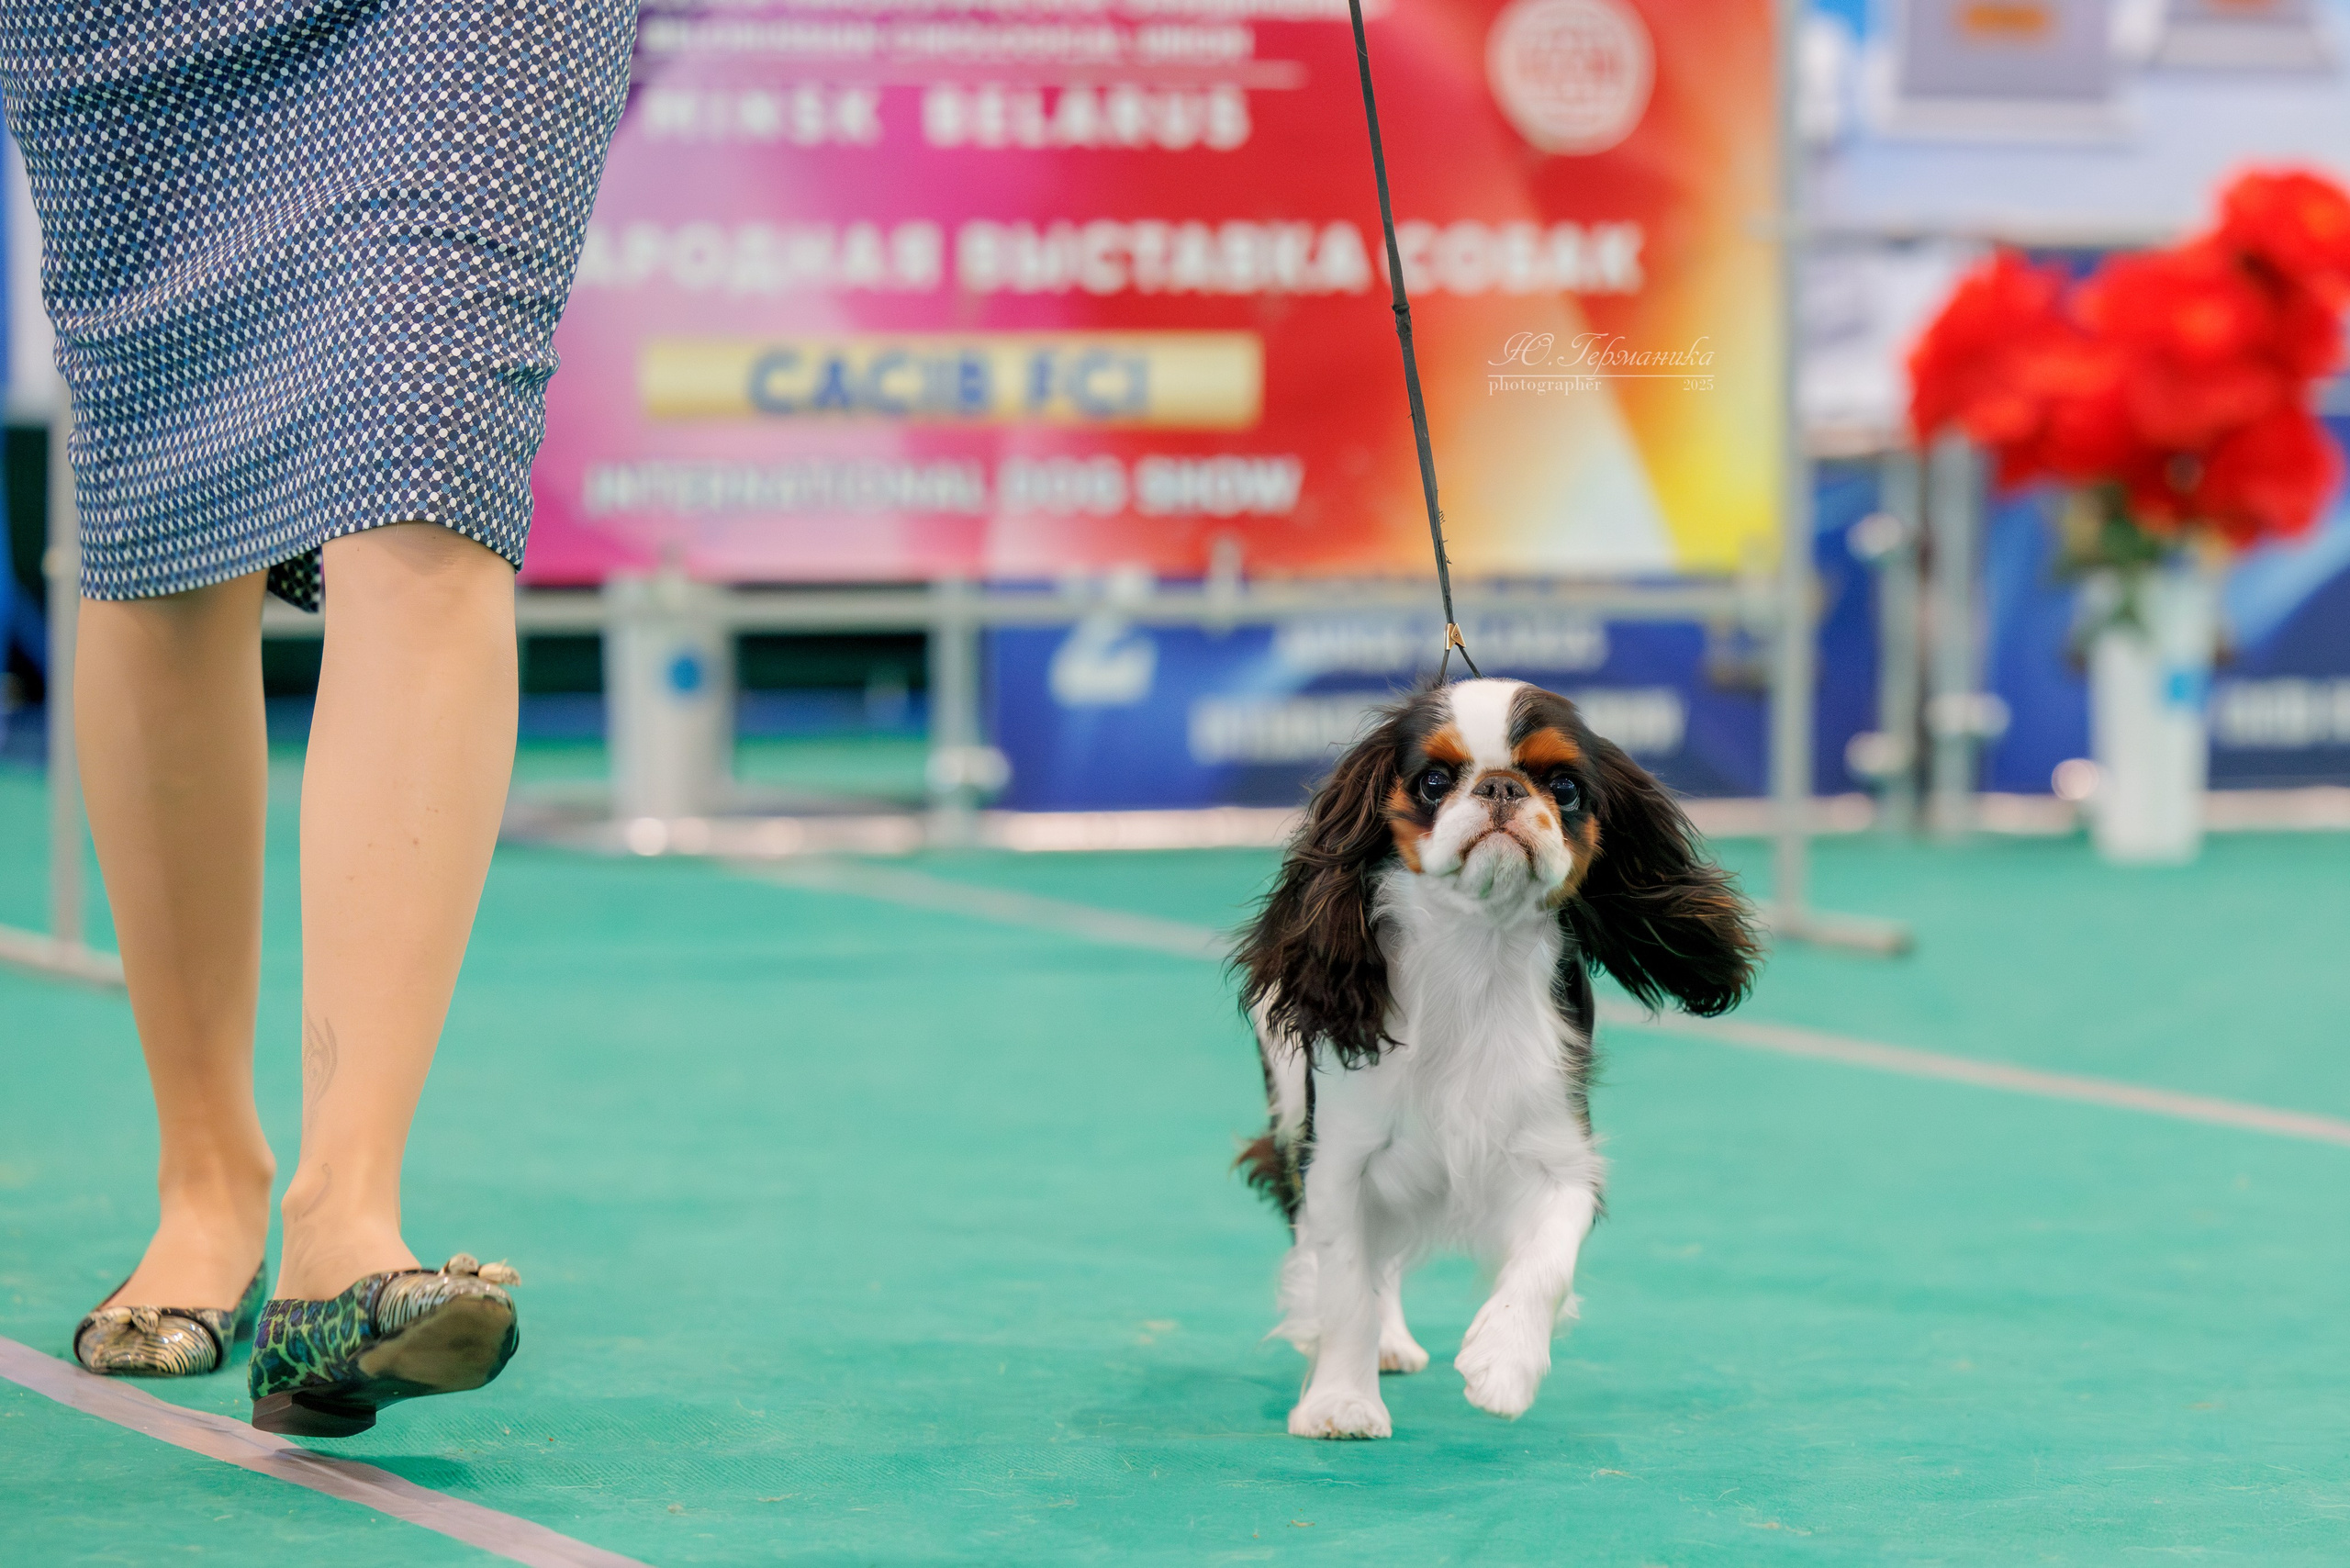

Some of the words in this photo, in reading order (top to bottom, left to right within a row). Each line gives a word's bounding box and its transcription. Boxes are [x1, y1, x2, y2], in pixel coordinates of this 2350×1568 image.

[924, 84, 1250, 148] BELARUS
[959, 219, 1369, 293] ВЫСТАВКА
[1382, 220, 1643, 292] СОБАК
[748, 348, 992, 415] CACIB
[1029, 350, 1149, 419] FCI
[584, 462, 984, 516] INTERNATIONAL
[1001, 459, 1128, 515] DOG
[1136, 457, 1303, 516] SHOW
